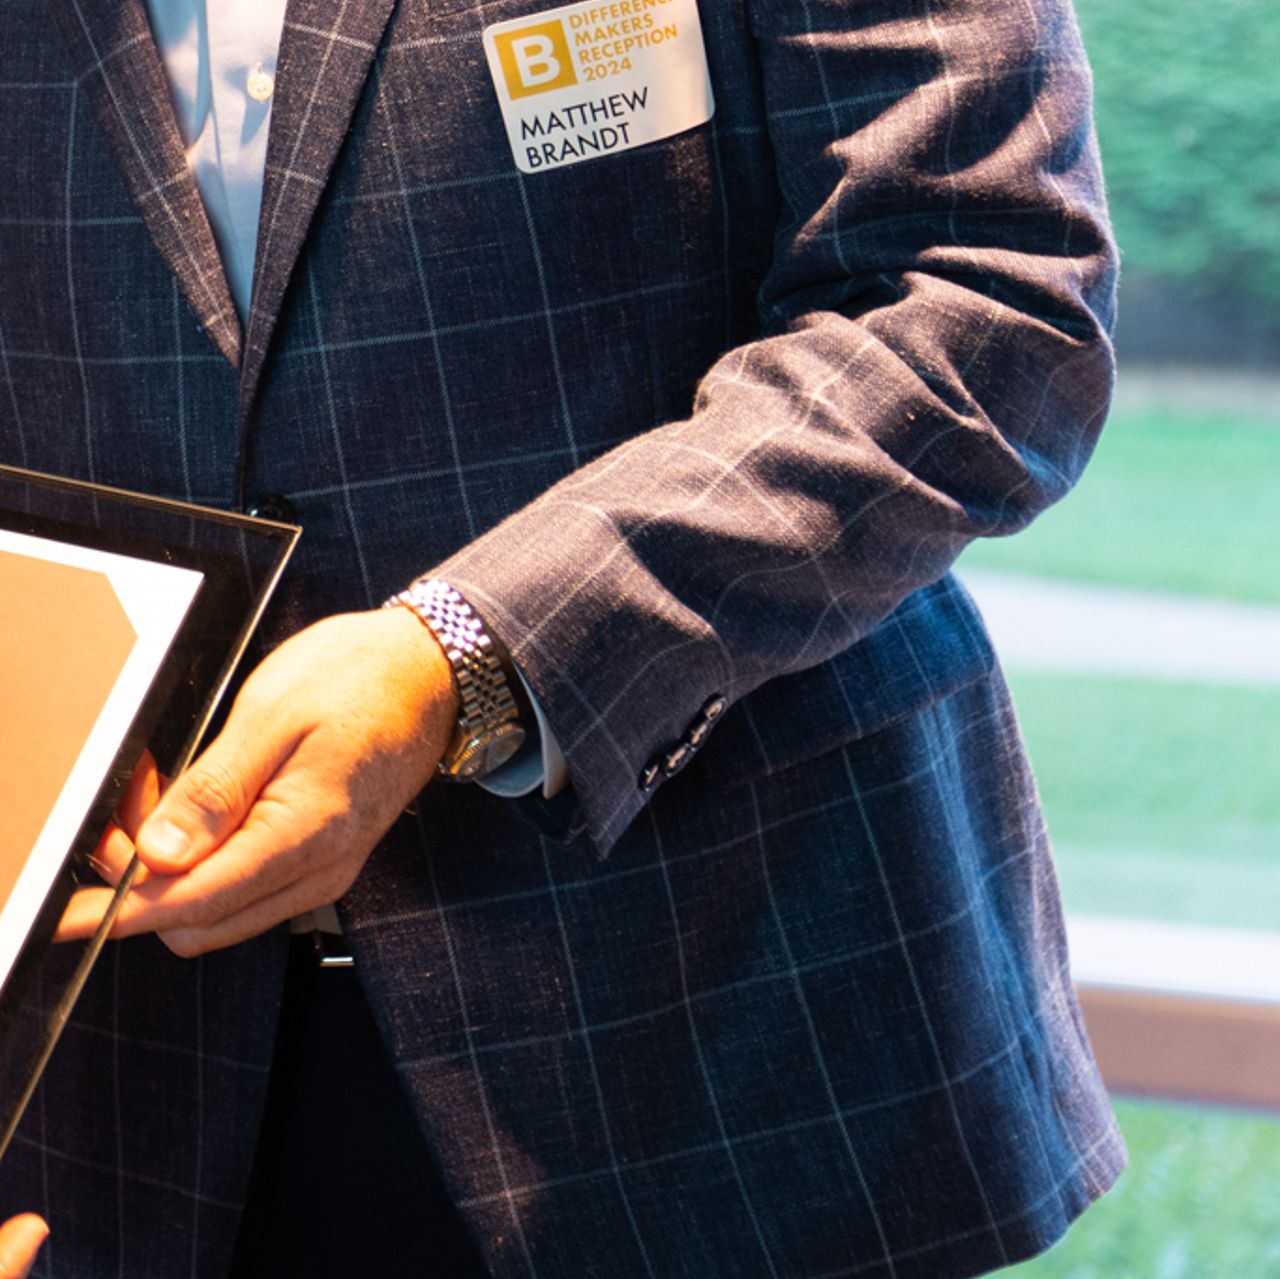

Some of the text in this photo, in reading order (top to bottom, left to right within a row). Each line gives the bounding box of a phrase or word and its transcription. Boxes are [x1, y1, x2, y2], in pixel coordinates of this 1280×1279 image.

[574, 12, 655, 47] MAKERS
[577, 23, 679, 64] RECEPTION
[511, 34, 561, 89] B
[582, 56, 633, 82] 2024
[520, 86, 649, 141] MATTHEW
[525, 122, 631, 169] BRANDT
